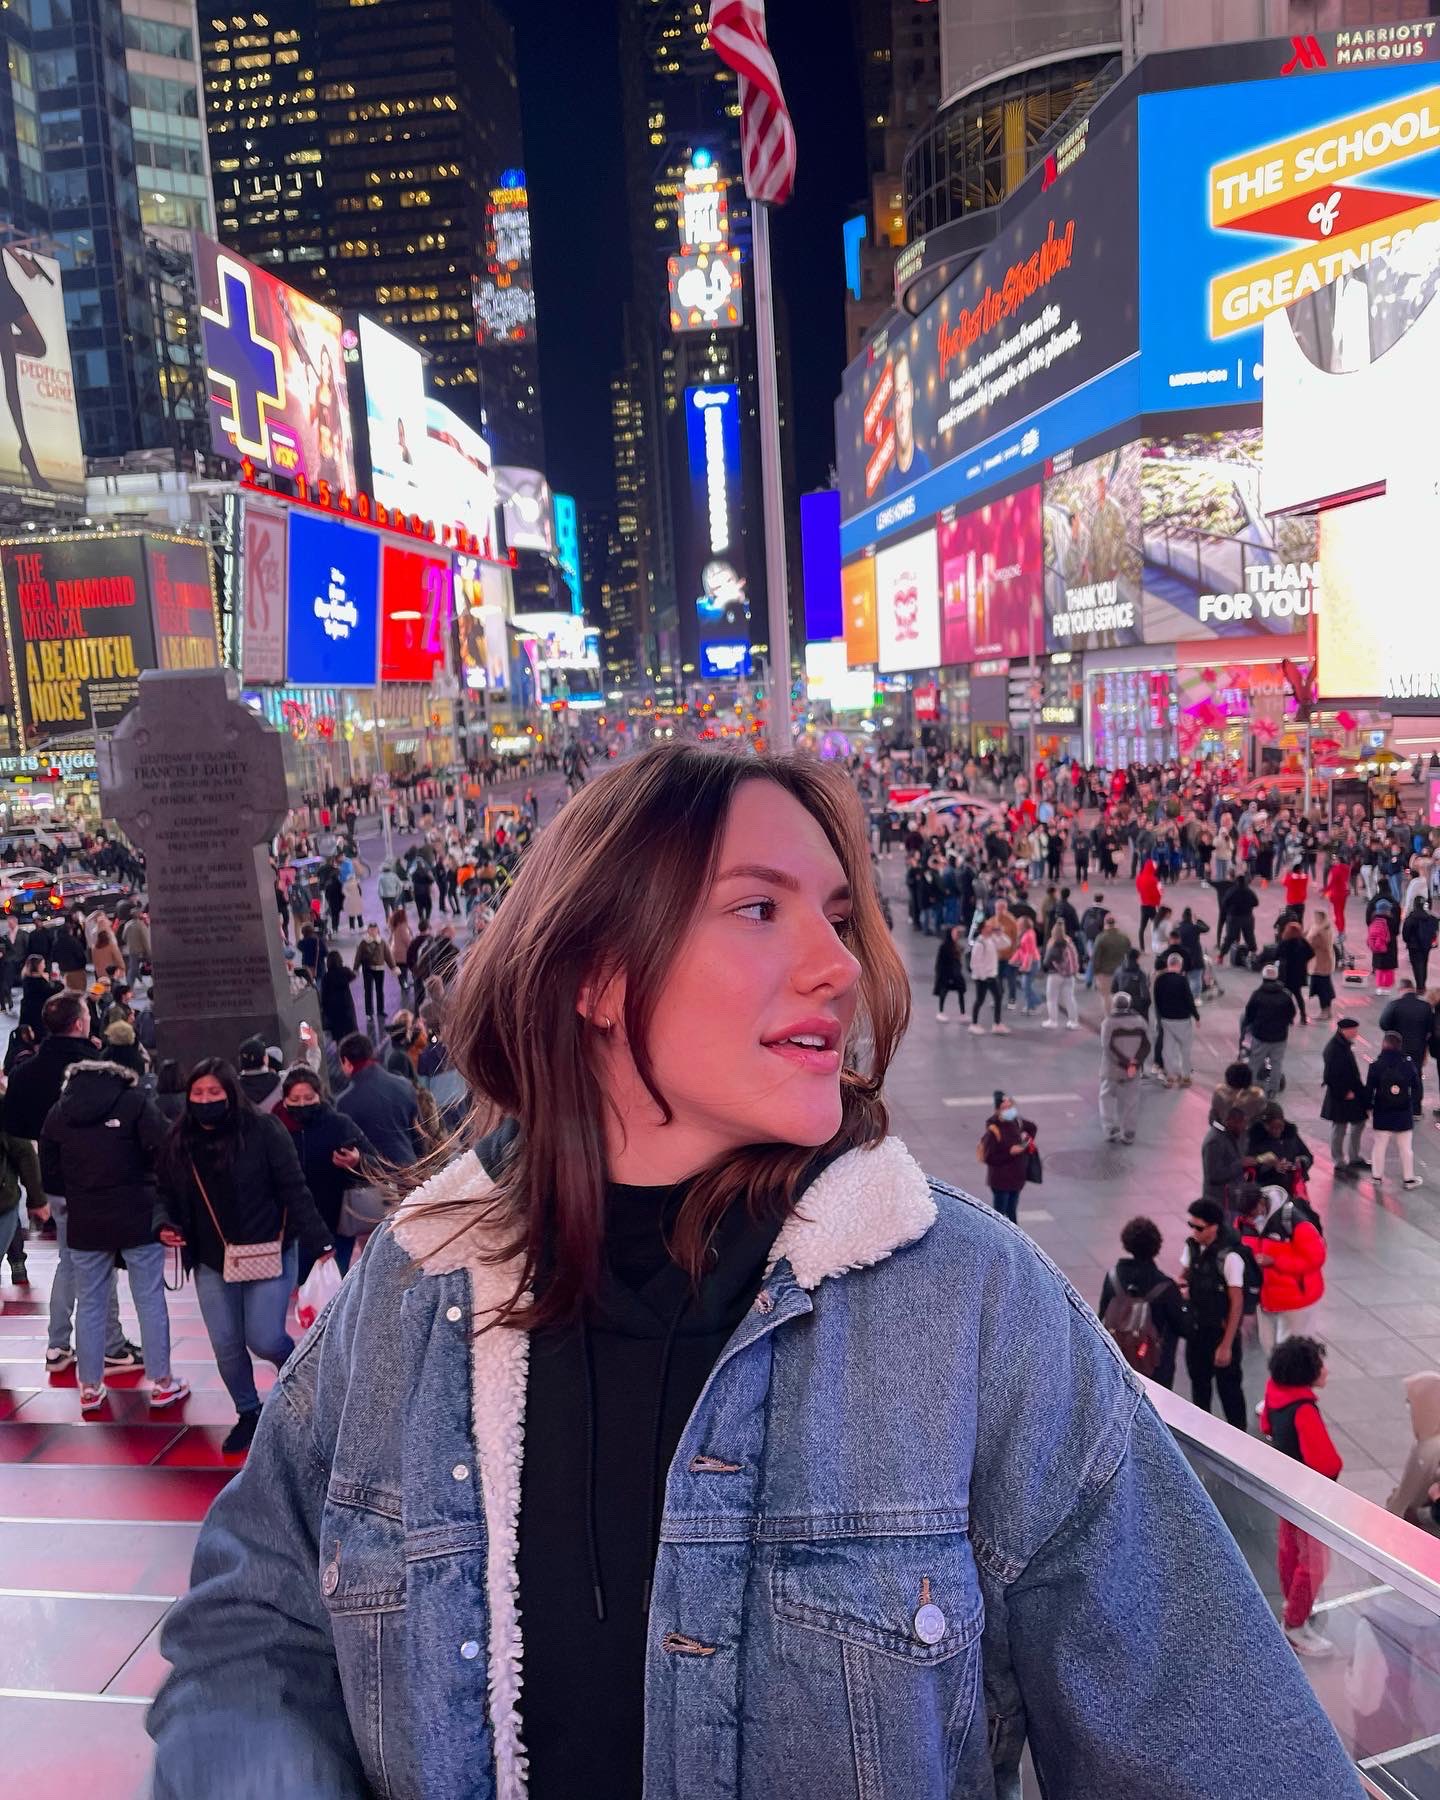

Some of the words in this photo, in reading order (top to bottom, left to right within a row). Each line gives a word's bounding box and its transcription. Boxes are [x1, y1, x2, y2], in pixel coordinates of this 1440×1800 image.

[1336, 22, 1436, 47] MARRIOTT
[1336, 41, 1424, 65] MARQUIS
[1216, 159, 1283, 209] THE
[1294, 107, 1440, 183] SCHOOL
[1307, 191, 1342, 235] of
[295, 471, 370, 518] 1540
[15, 553, 45, 583] THE
[1245, 562, 1319, 591] THAN
[18, 581, 56, 609] NEIL
[56, 575, 136, 609] DIAMOND
[1065, 583, 1096, 611] THANK
[1095, 580, 1118, 605] YOU
[1200, 593, 1253, 622] FOR
[21, 608, 88, 641] MUSICAL
[1052, 612, 1071, 637] FOR
[1070, 608, 1094, 634] YOUR
[1093, 602, 1135, 629] SERVICE
[25, 641, 41, 682] A
[40, 635, 140, 681] BEAUTIFUL
[28, 680, 86, 722] NOISE
[0, 756, 39, 772] IFTS
[49, 753, 97, 769] LUGG
[134, 765, 187, 780] FRANCIS
[203, 761, 248, 776] DUFFY
